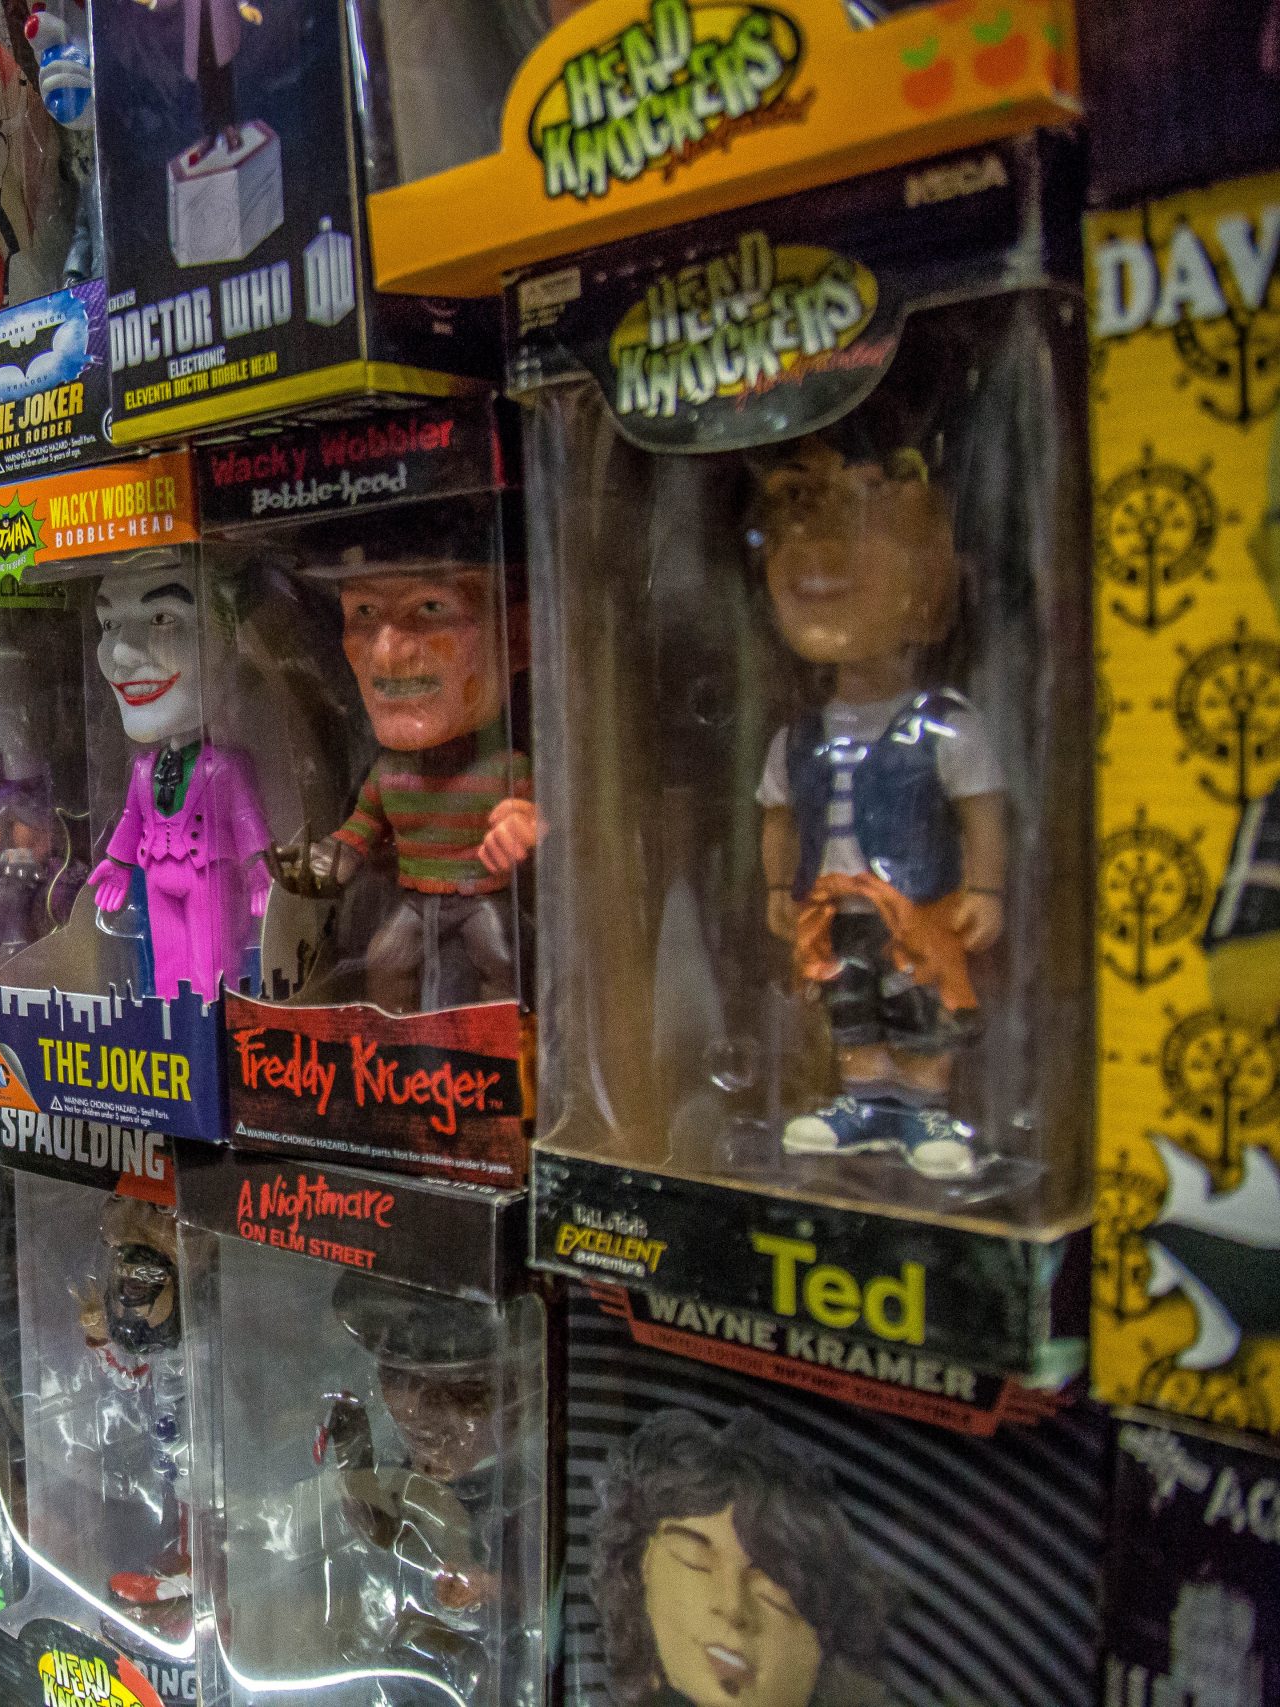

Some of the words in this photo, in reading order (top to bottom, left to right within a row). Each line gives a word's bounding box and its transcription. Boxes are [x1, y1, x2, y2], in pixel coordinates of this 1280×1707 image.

[565, 0, 693, 128] HEAD
[541, 15, 783, 199] KNOCKERS
[110, 287, 212, 373] DOCTOR
[221, 261, 290, 340] WHO
[647, 231, 776, 348] HEAD
[2, 326, 25, 339] DARK
[618, 260, 862, 416] KNOCKERS
[7, 376, 48, 392] TRILOGY
[125, 382, 171, 410] ELEVENTH
[173, 372, 209, 397] DOCTOR
[211, 359, 248, 387] BOBBLE
[250, 351, 277, 377] HEAD
[169, 345, 225, 379] ELECTRONIC
[19, 382, 84, 429] JOKER
[26, 420, 72, 445] ROBBER
[211, 444, 307, 486] Wacky
[322, 419, 453, 466] Wobbler
[49, 491, 99, 529] WACKY
[101, 477, 176, 521] WOBBLER
[38, 1037, 92, 1087] THE
[96, 1045, 192, 1102] JOKER
[233, 1027, 337, 1115] Freddy
[351, 1035, 501, 1136] Krueger
[64, 1104, 73, 1112] Not
[73, 1106, 81, 1114] for
[82, 1107, 100, 1117] children
[120, 1115, 134, 1124] years
[90, 1099, 115, 1111] CHOKING
[115, 1104, 137, 1115] HAZARD
[141, 1107, 155, 1118] Small
[1, 1107, 164, 1181] SPAULDING
[282, 1134, 316, 1147] CHOKING
[349, 1144, 370, 1155] Small
[394, 1150, 407, 1160] Not
[409, 1152, 420, 1162] for
[421, 1154, 454, 1167] children
[455, 1160, 479, 1171] under
[237, 1180, 253, 1232] A
[258, 1175, 396, 1232] Nightmare
[240, 1224, 266, 1244] ON
[270, 1231, 305, 1254] ELM
[308, 1239, 376, 1270] STREET
[555, 1223, 668, 1273] EXCELLENT
[752, 1231, 926, 1345] Ted
[646, 1295, 777, 1351] WAYNE
[786, 1324, 977, 1401] KRAMER
[53, 1649, 111, 1700] HEAD
